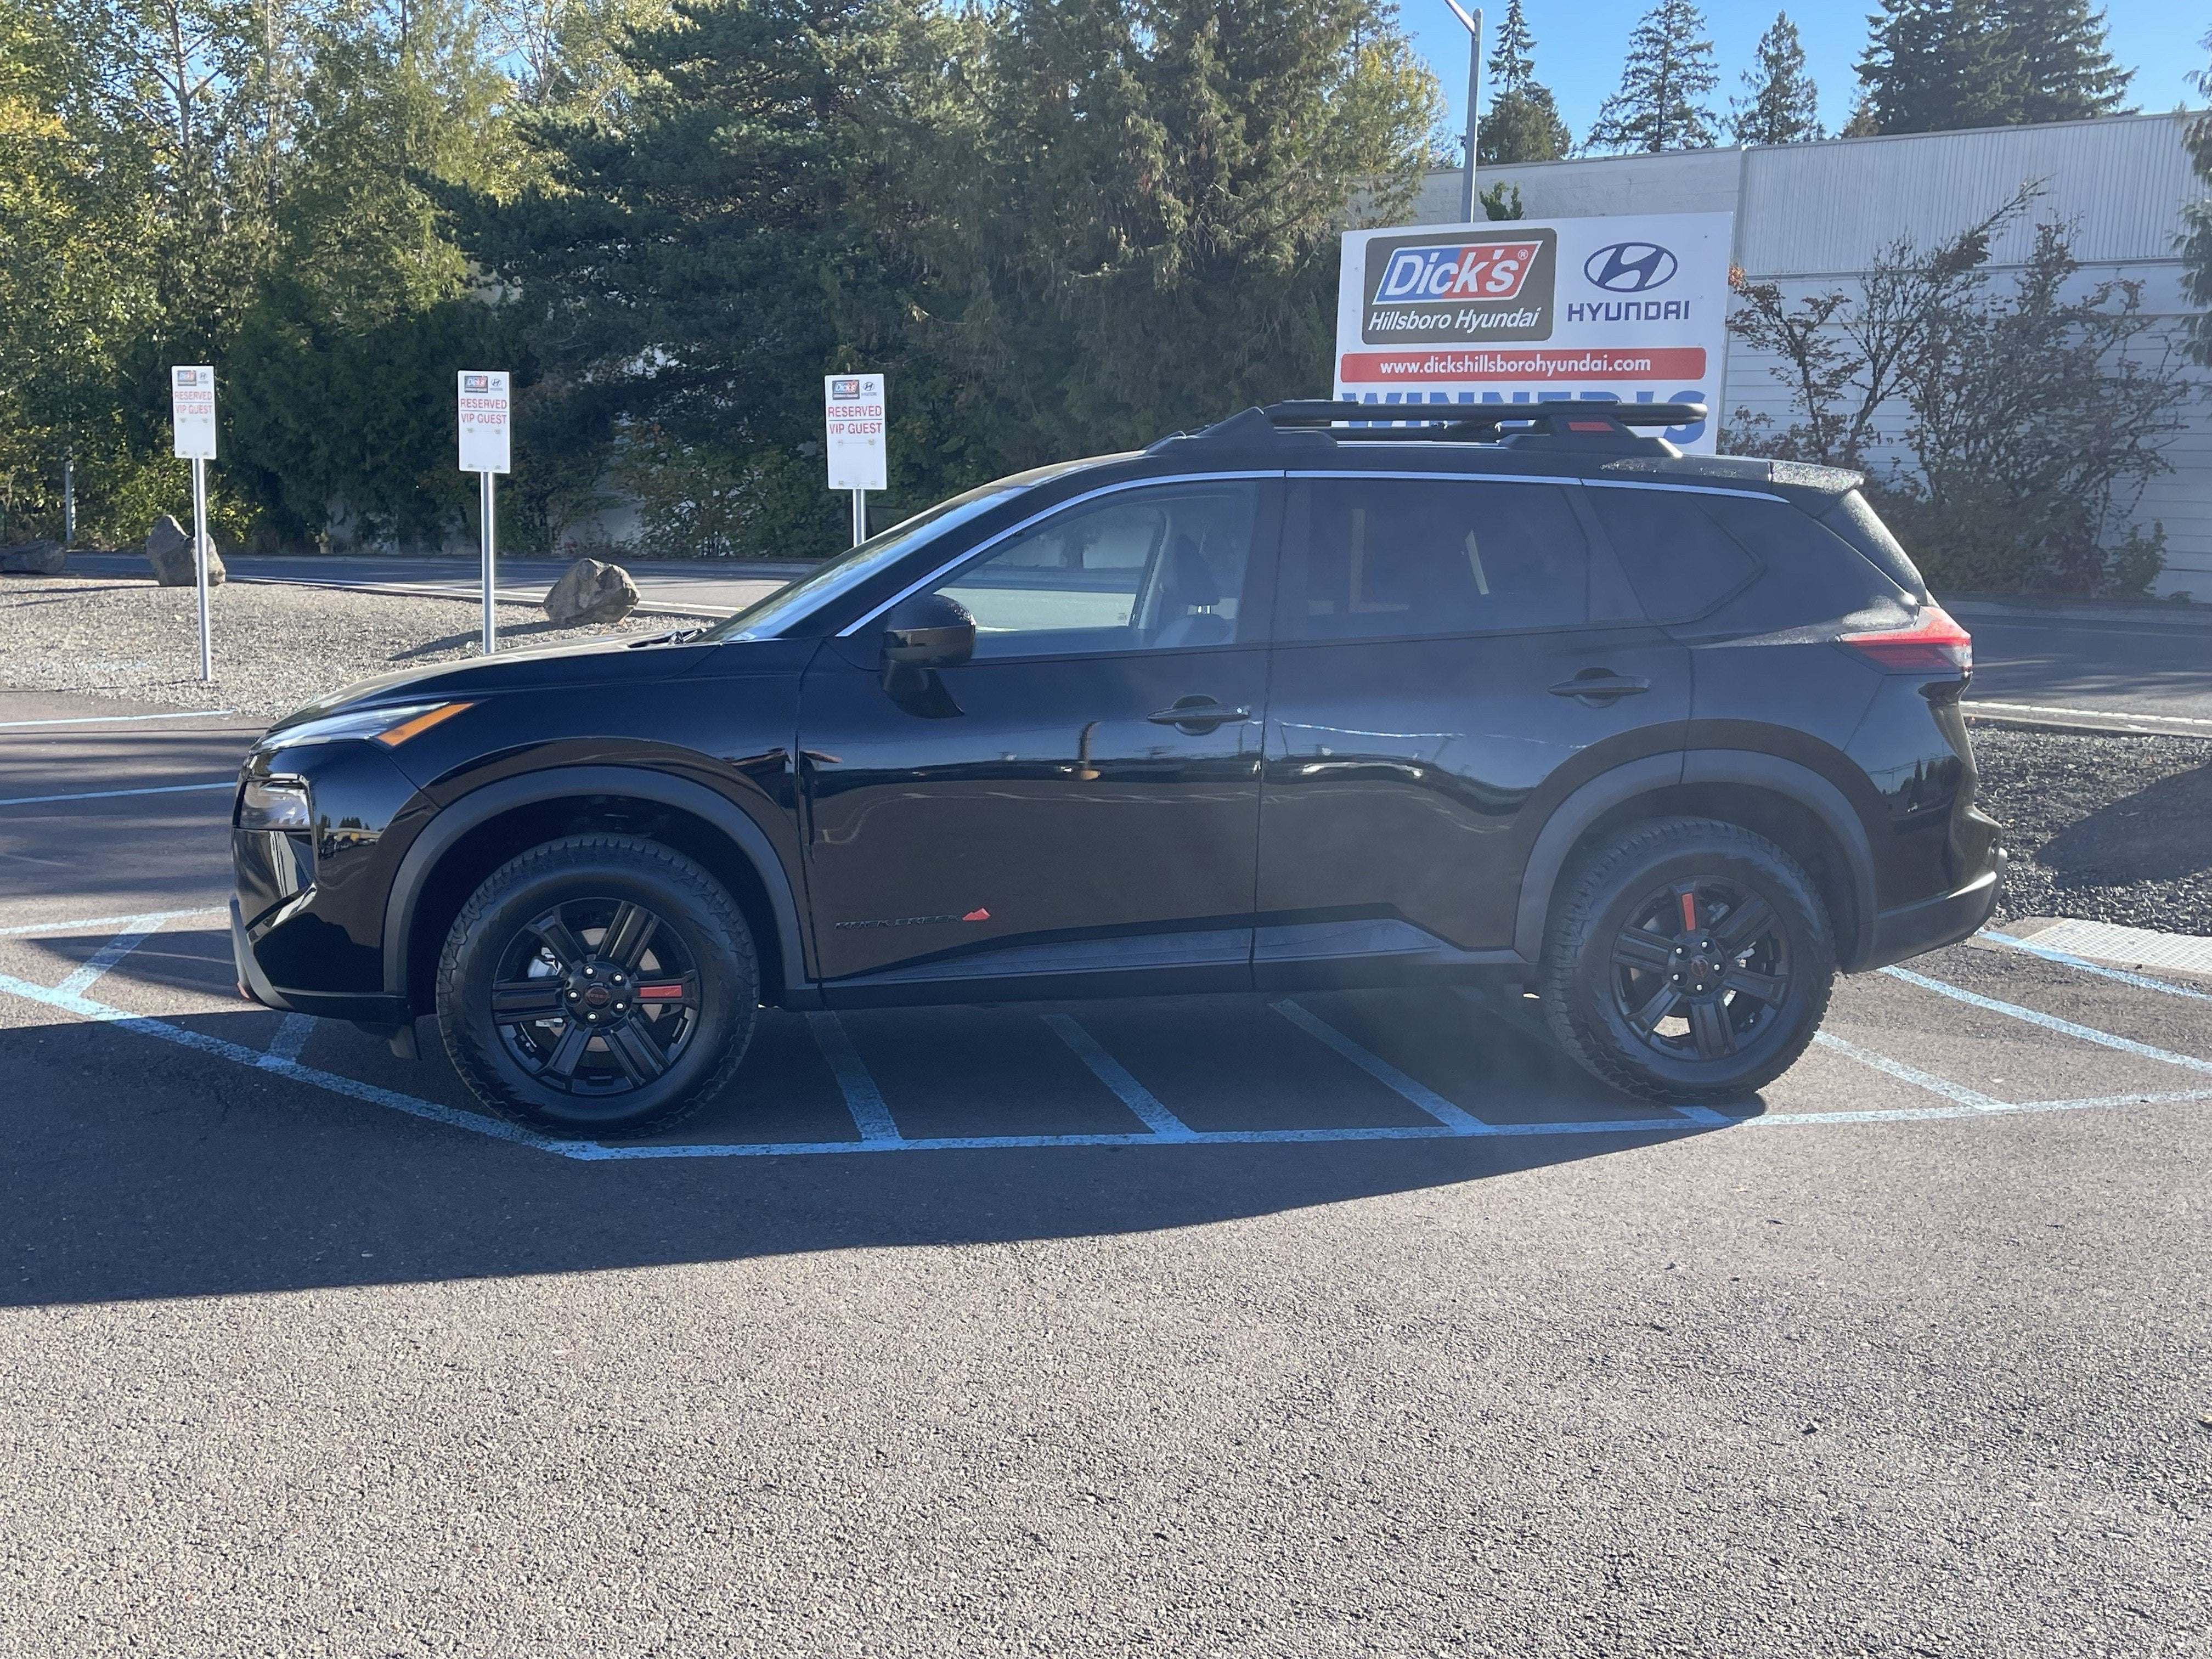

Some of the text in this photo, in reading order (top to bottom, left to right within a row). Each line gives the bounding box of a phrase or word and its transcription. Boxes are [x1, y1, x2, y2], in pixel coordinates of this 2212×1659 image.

[1567, 300, 1689, 322] HYUNDAI
[1368, 307, 1542, 334] Hillsboro Hyundai
[1380, 353, 1651, 377] www.dickshillsborohyundai.com
[174, 391, 212, 400] RESERVED
[175, 405, 212, 414] VIP GUEST
[460, 398, 507, 409] RESERVED
[828, 405, 882, 417] RESERVED
[461, 413, 507, 425] VIP GUEST
[829, 422, 883, 435] VIP GUEST
